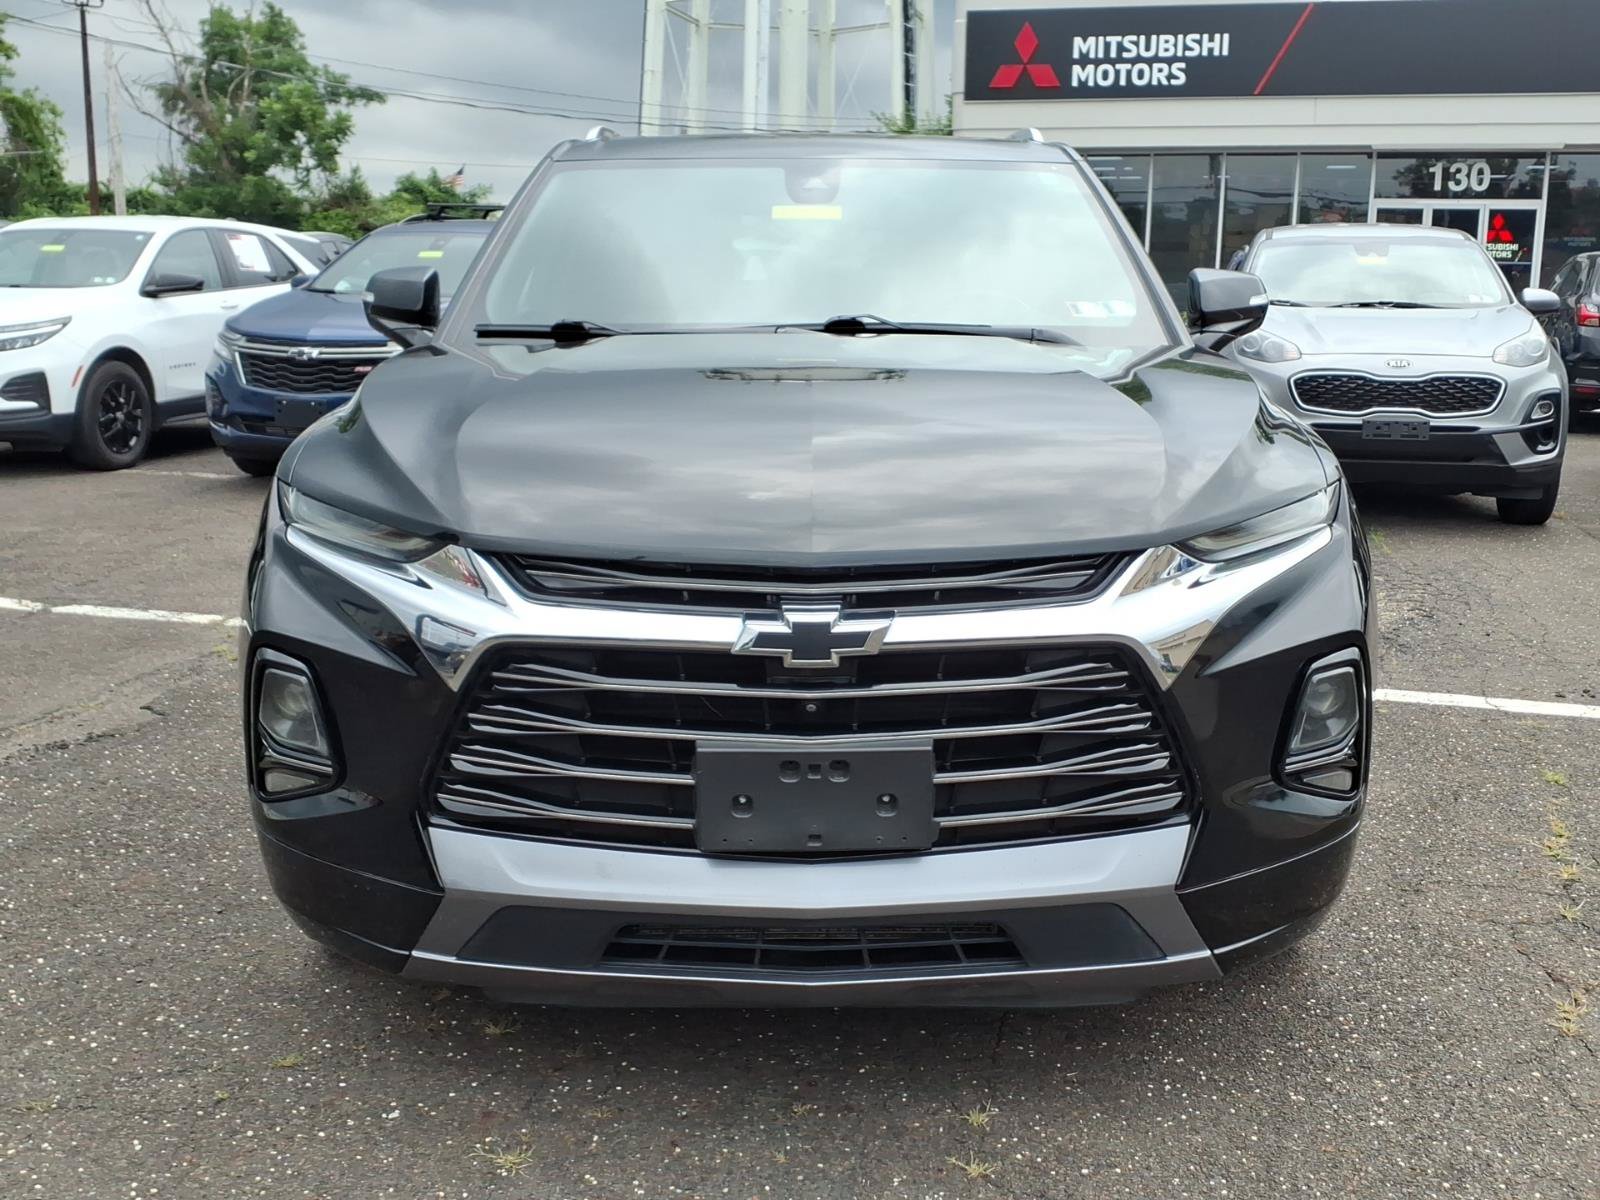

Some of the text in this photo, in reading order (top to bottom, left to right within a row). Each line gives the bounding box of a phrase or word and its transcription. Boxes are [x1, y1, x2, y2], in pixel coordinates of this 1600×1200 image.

[1072, 33, 1230, 59] MITSUBISHI
[1071, 62, 1187, 87] MOTORS
[1428, 162, 1491, 192] 130
[1487, 243, 1519, 251] SUBISHI
